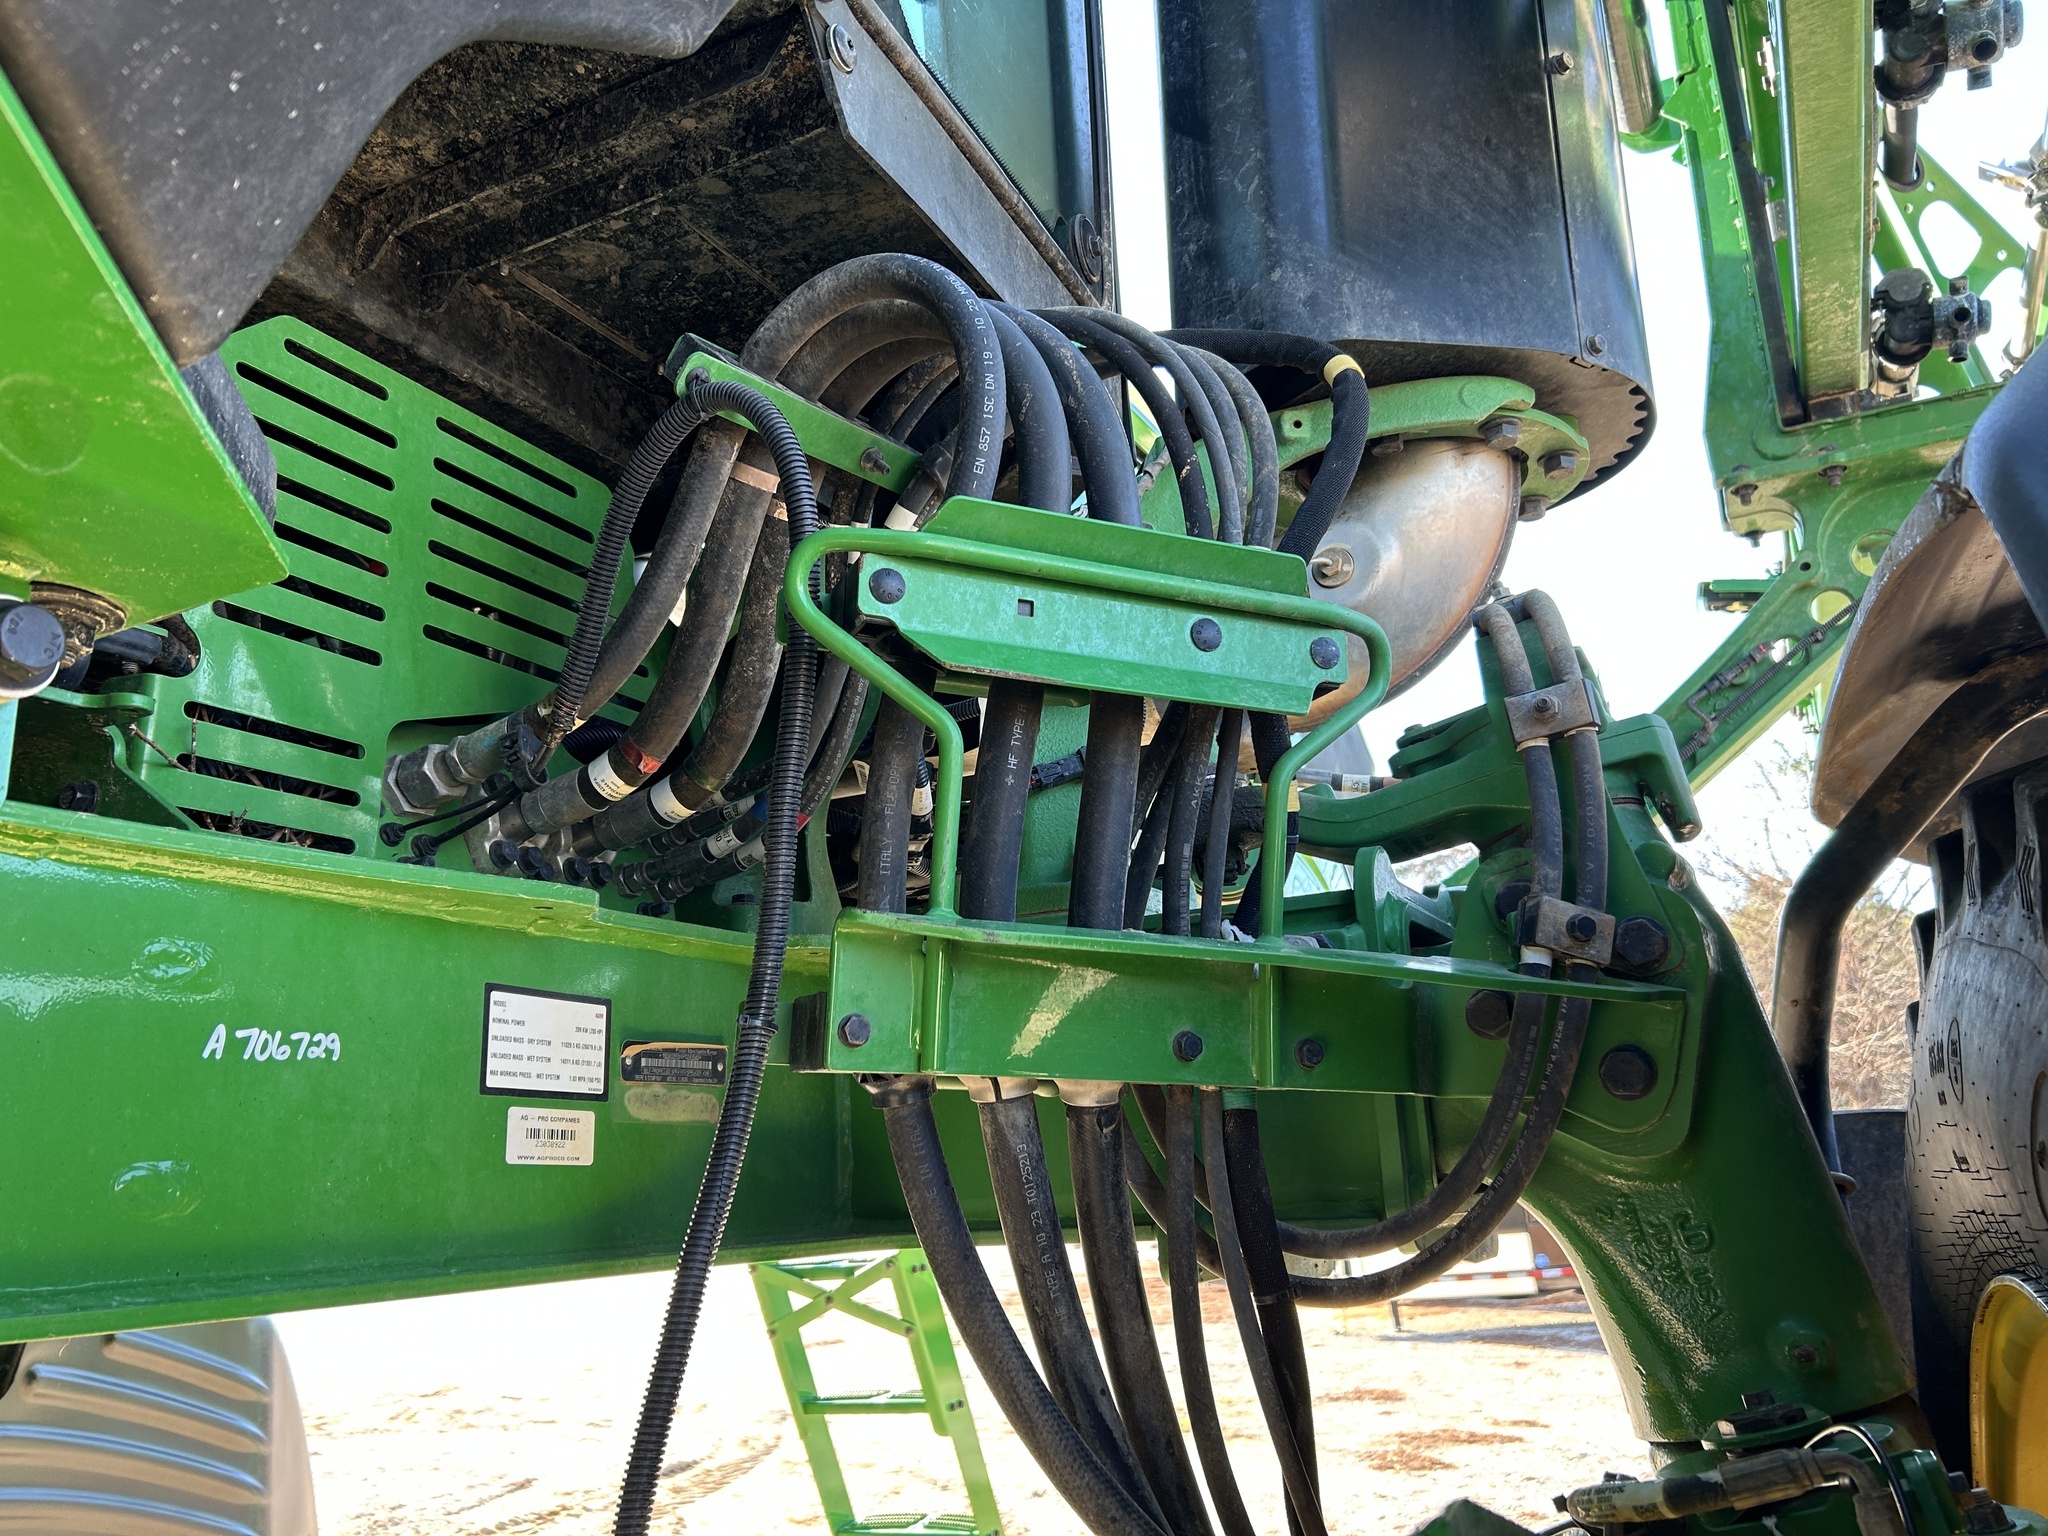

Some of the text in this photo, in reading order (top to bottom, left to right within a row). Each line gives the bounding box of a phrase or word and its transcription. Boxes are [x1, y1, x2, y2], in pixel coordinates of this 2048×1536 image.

[944, 273, 968, 295] MADE
[965, 298, 979, 312] 23
[974, 317, 986, 330] 10
[983, 351, 993, 366] 19
[984, 373, 994, 390] DN
[978, 427, 991, 452] 857
[973, 457, 986, 475] EN
[1011, 717, 1025, 746] TYPE
[1007, 752, 1018, 769] HF
[879, 837, 893, 876] ITALY
[493, 1000, 507, 1008] MODEL
[492, 1017, 525, 1027] NOMINAL POWER
[202, 1023, 341, 1062] A 706729
[491, 1035, 512, 1043] UNLOADED
[514, 1036, 524, 1044] MASS
[536, 1039, 552, 1047] SYSTEM
[490, 1052, 512, 1060] UNLOADED
[499, 1070, 518, 1078] WORKING
[536, 1072, 544, 1080] WET
[550, 1116, 581, 1124] COMPANIES
[535, 1140, 566, 1148] 23038922
[910, 1118, 925, 1157] ITALY
[918, 1164, 932, 1181] IN
[926, 1186, 945, 1221] MADE
[1032, 1210, 1042, 1228] 23
[1036, 1232, 1047, 1248] 10
[1041, 1255, 1052, 1264] A
[1046, 1269, 1061, 1300] TYPE
